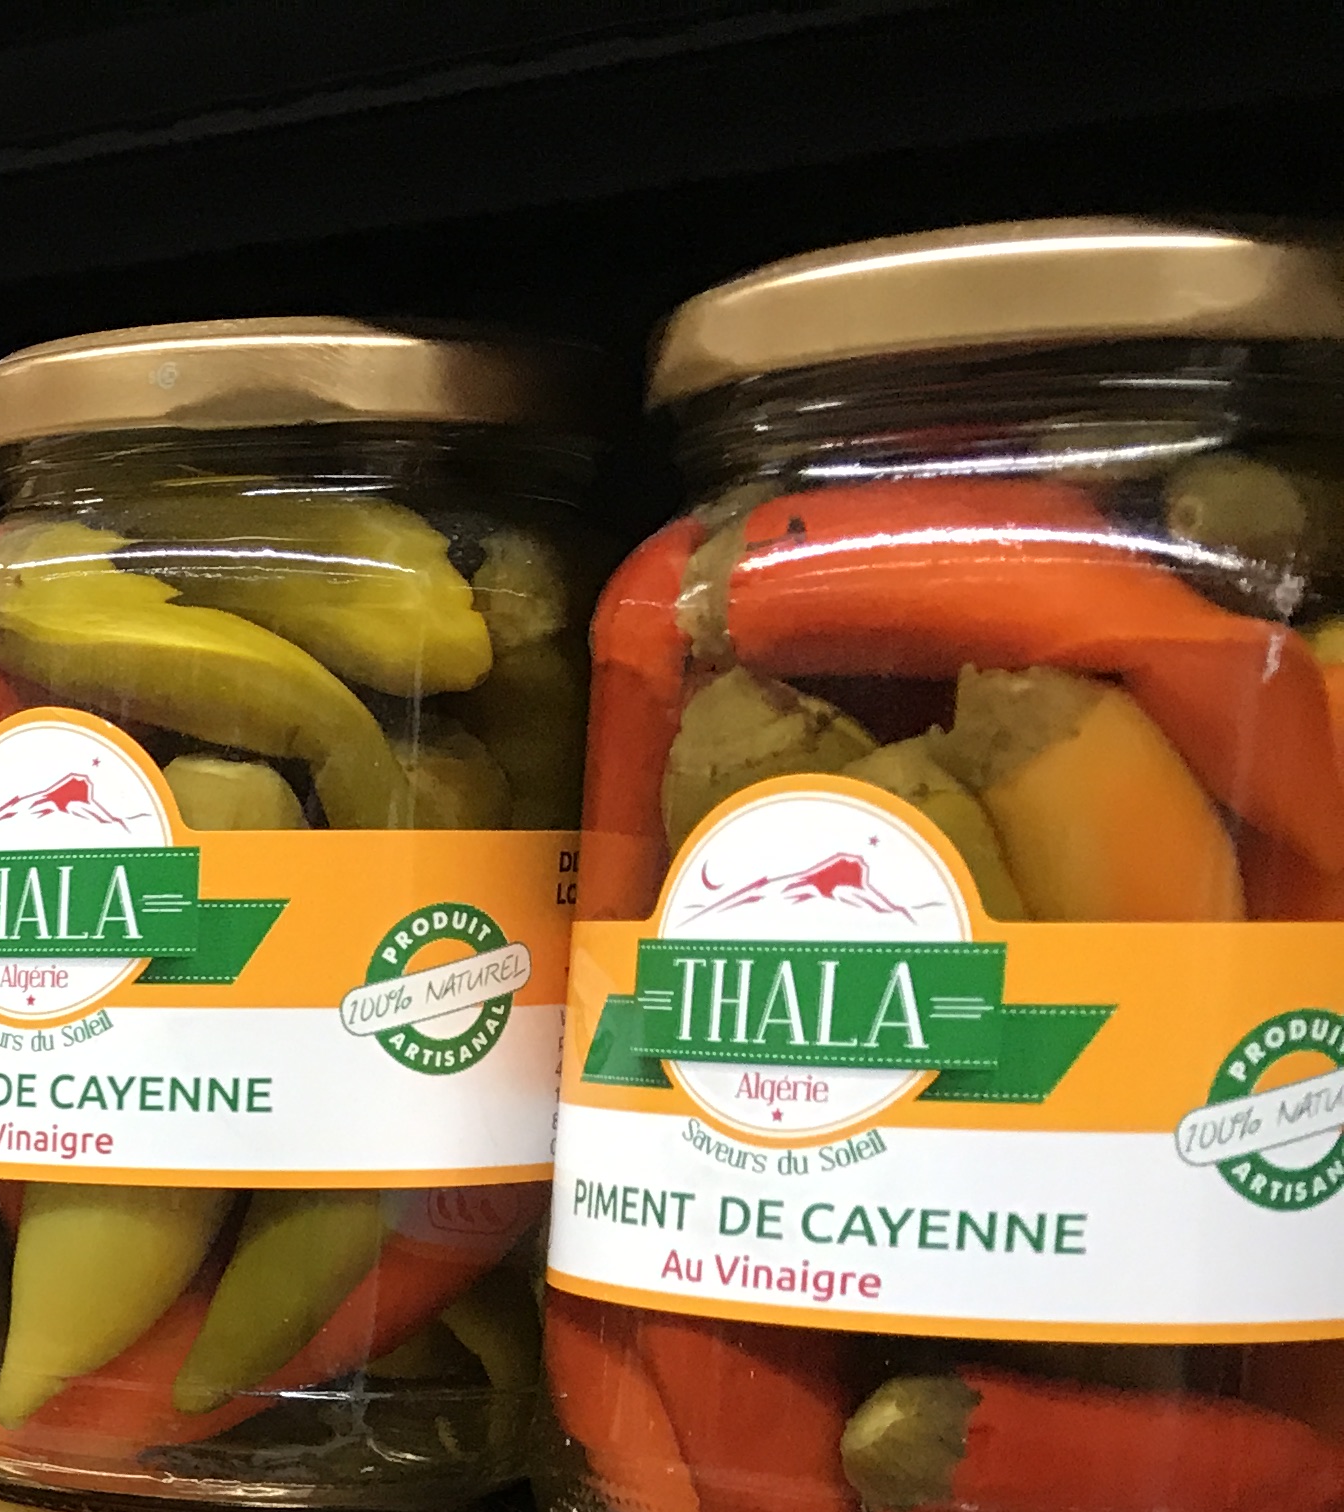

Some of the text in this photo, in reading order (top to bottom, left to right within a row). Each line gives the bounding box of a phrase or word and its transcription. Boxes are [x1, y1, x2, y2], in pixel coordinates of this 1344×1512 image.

[381, 910, 492, 965] PRODUIT
[348, 953, 526, 1025] 100% NATUREL
[671, 957, 929, 1051] THALA
[31, 1027, 54, 1053] du
[61, 1008, 114, 1048] Soleil
[388, 1004, 505, 1068] ARTISANAL
[49, 1073, 273, 1115] CAYENNE
[734, 1071, 830, 1107] Algérie
[681, 1117, 890, 1178] Saveurs du Soleil
[1185, 1105, 1262, 1153] 100%
[572, 1177, 1090, 1257] PIMENT DE CAYENNE
[661, 1249, 883, 1303] Au Vinaigre
